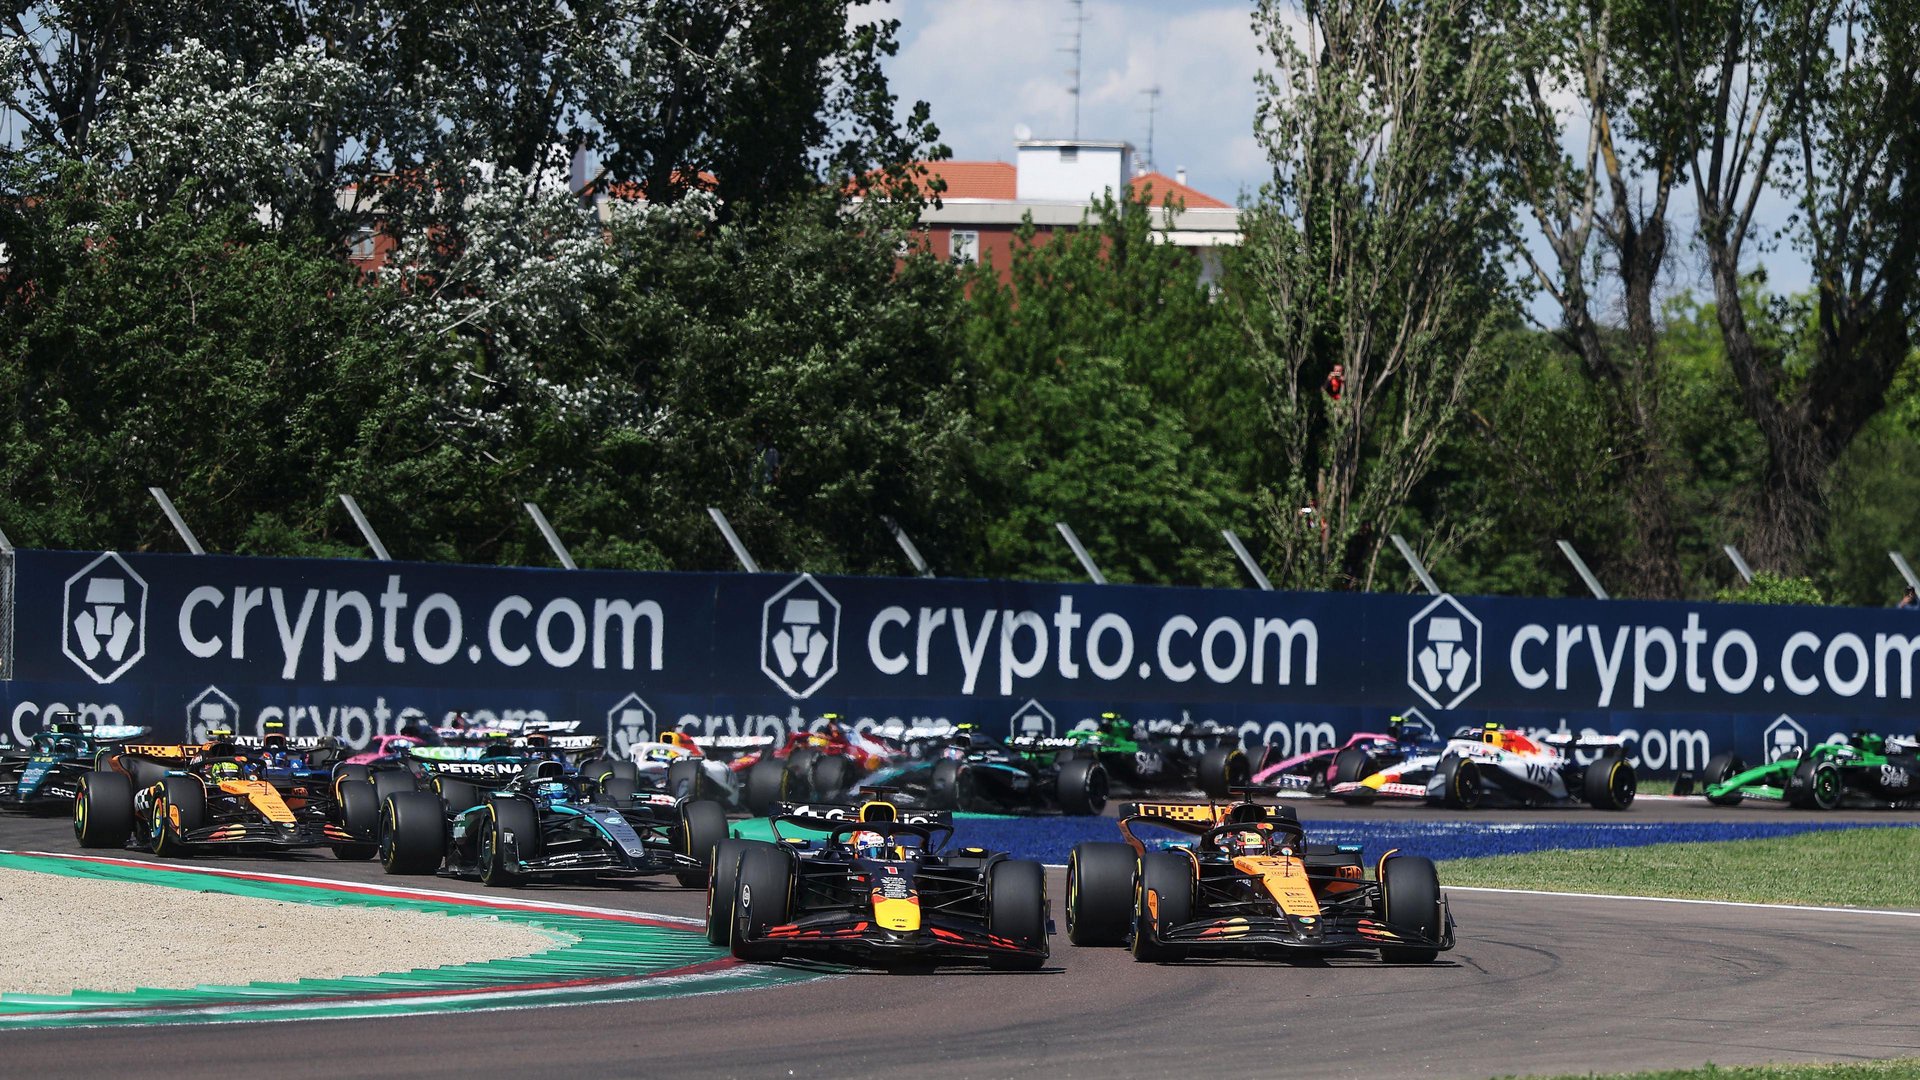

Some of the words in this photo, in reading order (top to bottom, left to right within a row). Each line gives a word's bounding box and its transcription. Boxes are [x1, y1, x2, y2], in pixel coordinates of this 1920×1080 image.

[178, 575, 664, 682] crypto.com
[867, 595, 1319, 696] crypto.com
[1509, 612, 1920, 709] crypto.com
[438, 763, 527, 774] PETRONA
[1014, 736, 1078, 747] PEONAS
